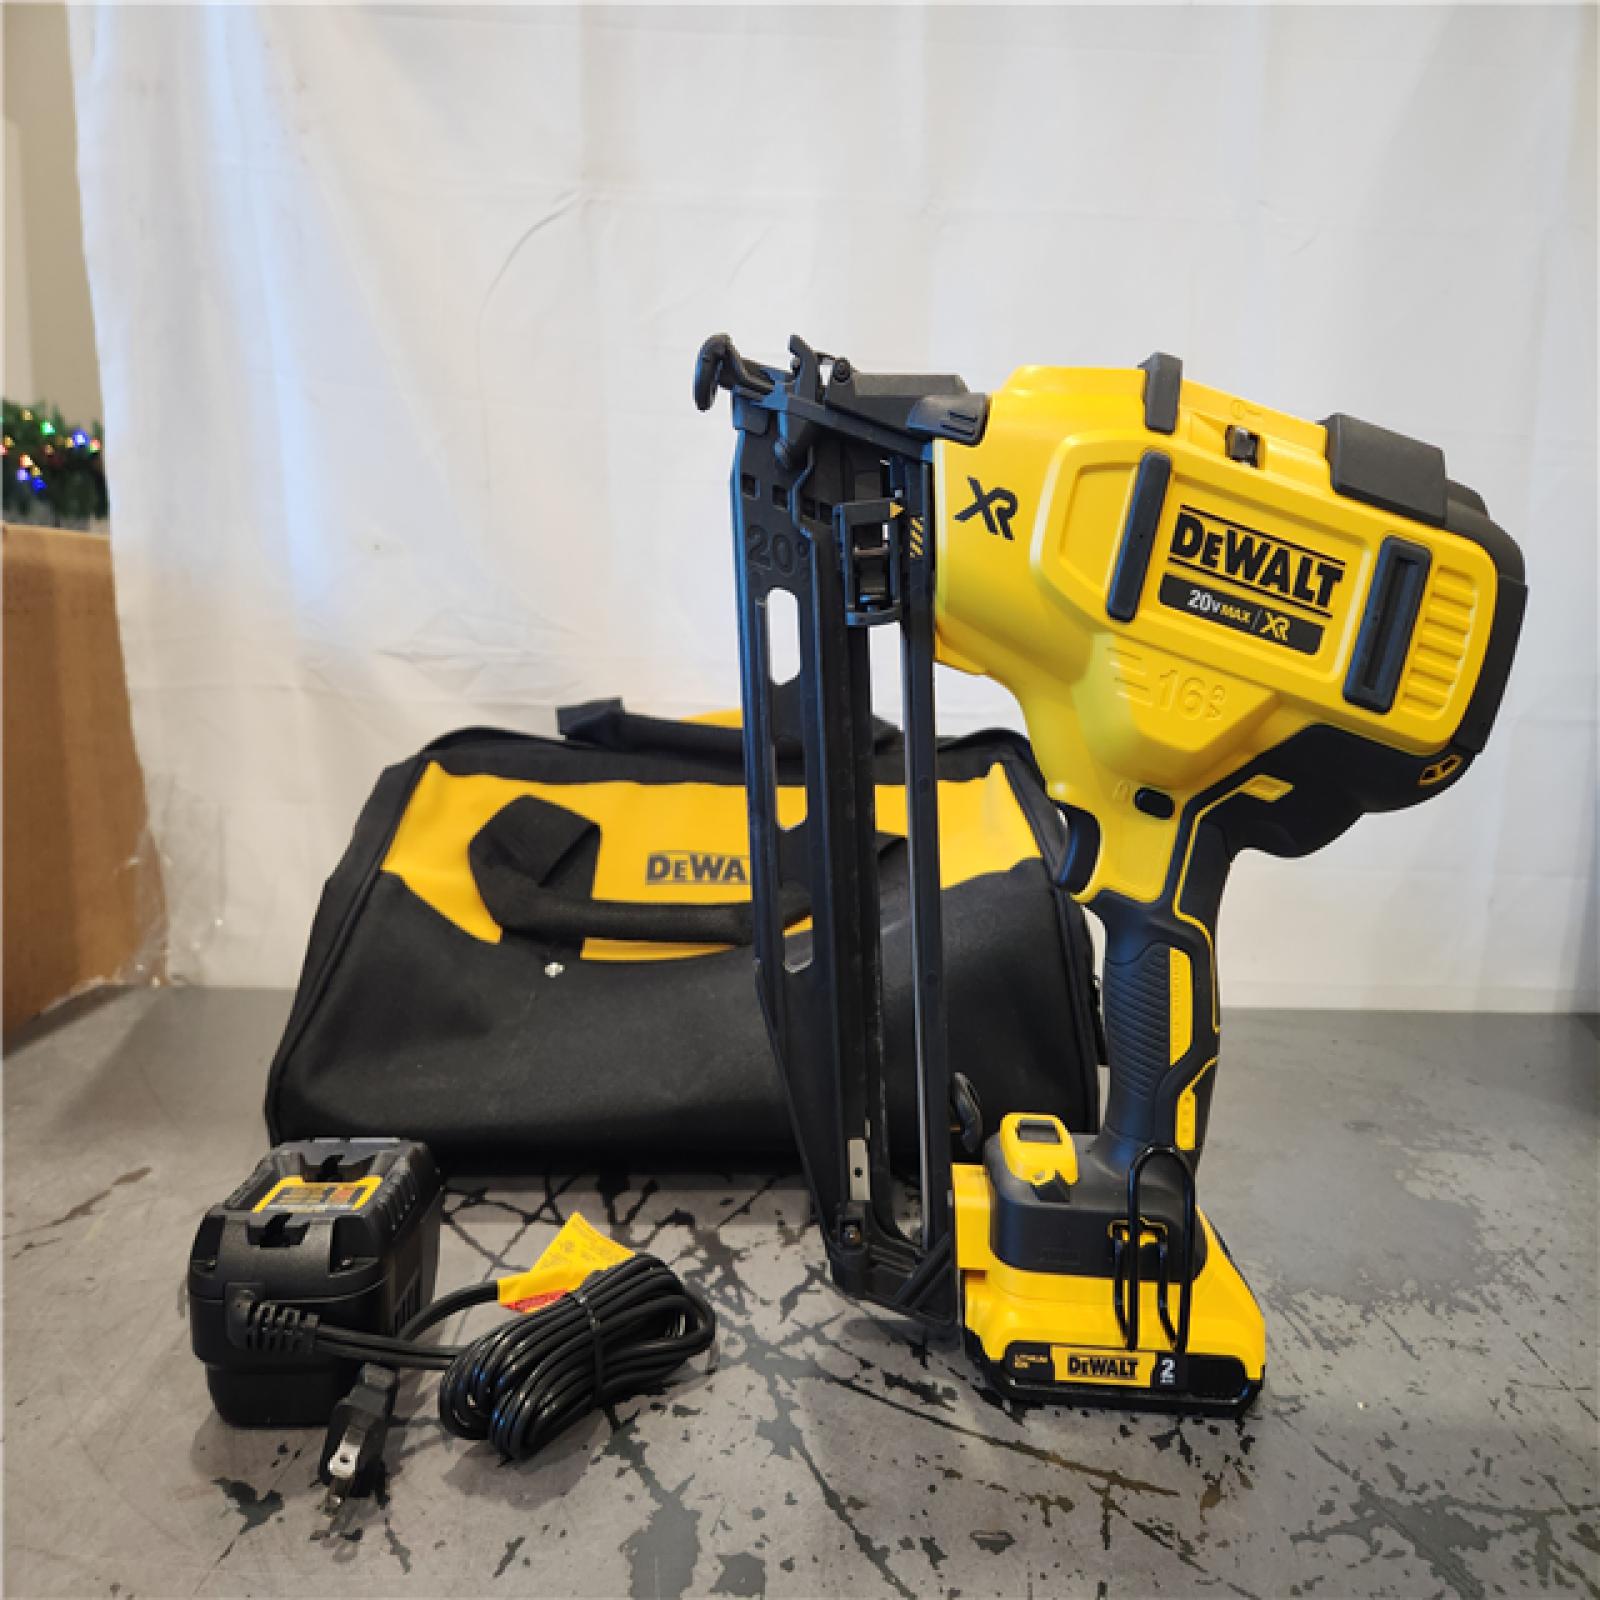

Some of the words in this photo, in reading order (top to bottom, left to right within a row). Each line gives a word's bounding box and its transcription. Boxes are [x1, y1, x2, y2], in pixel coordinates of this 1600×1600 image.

[953, 475, 1018, 541] XR
[1169, 511, 1345, 608] DEWALT
[647, 853, 746, 881] DEWA
[1068, 1355, 1138, 1377] DEWALT
